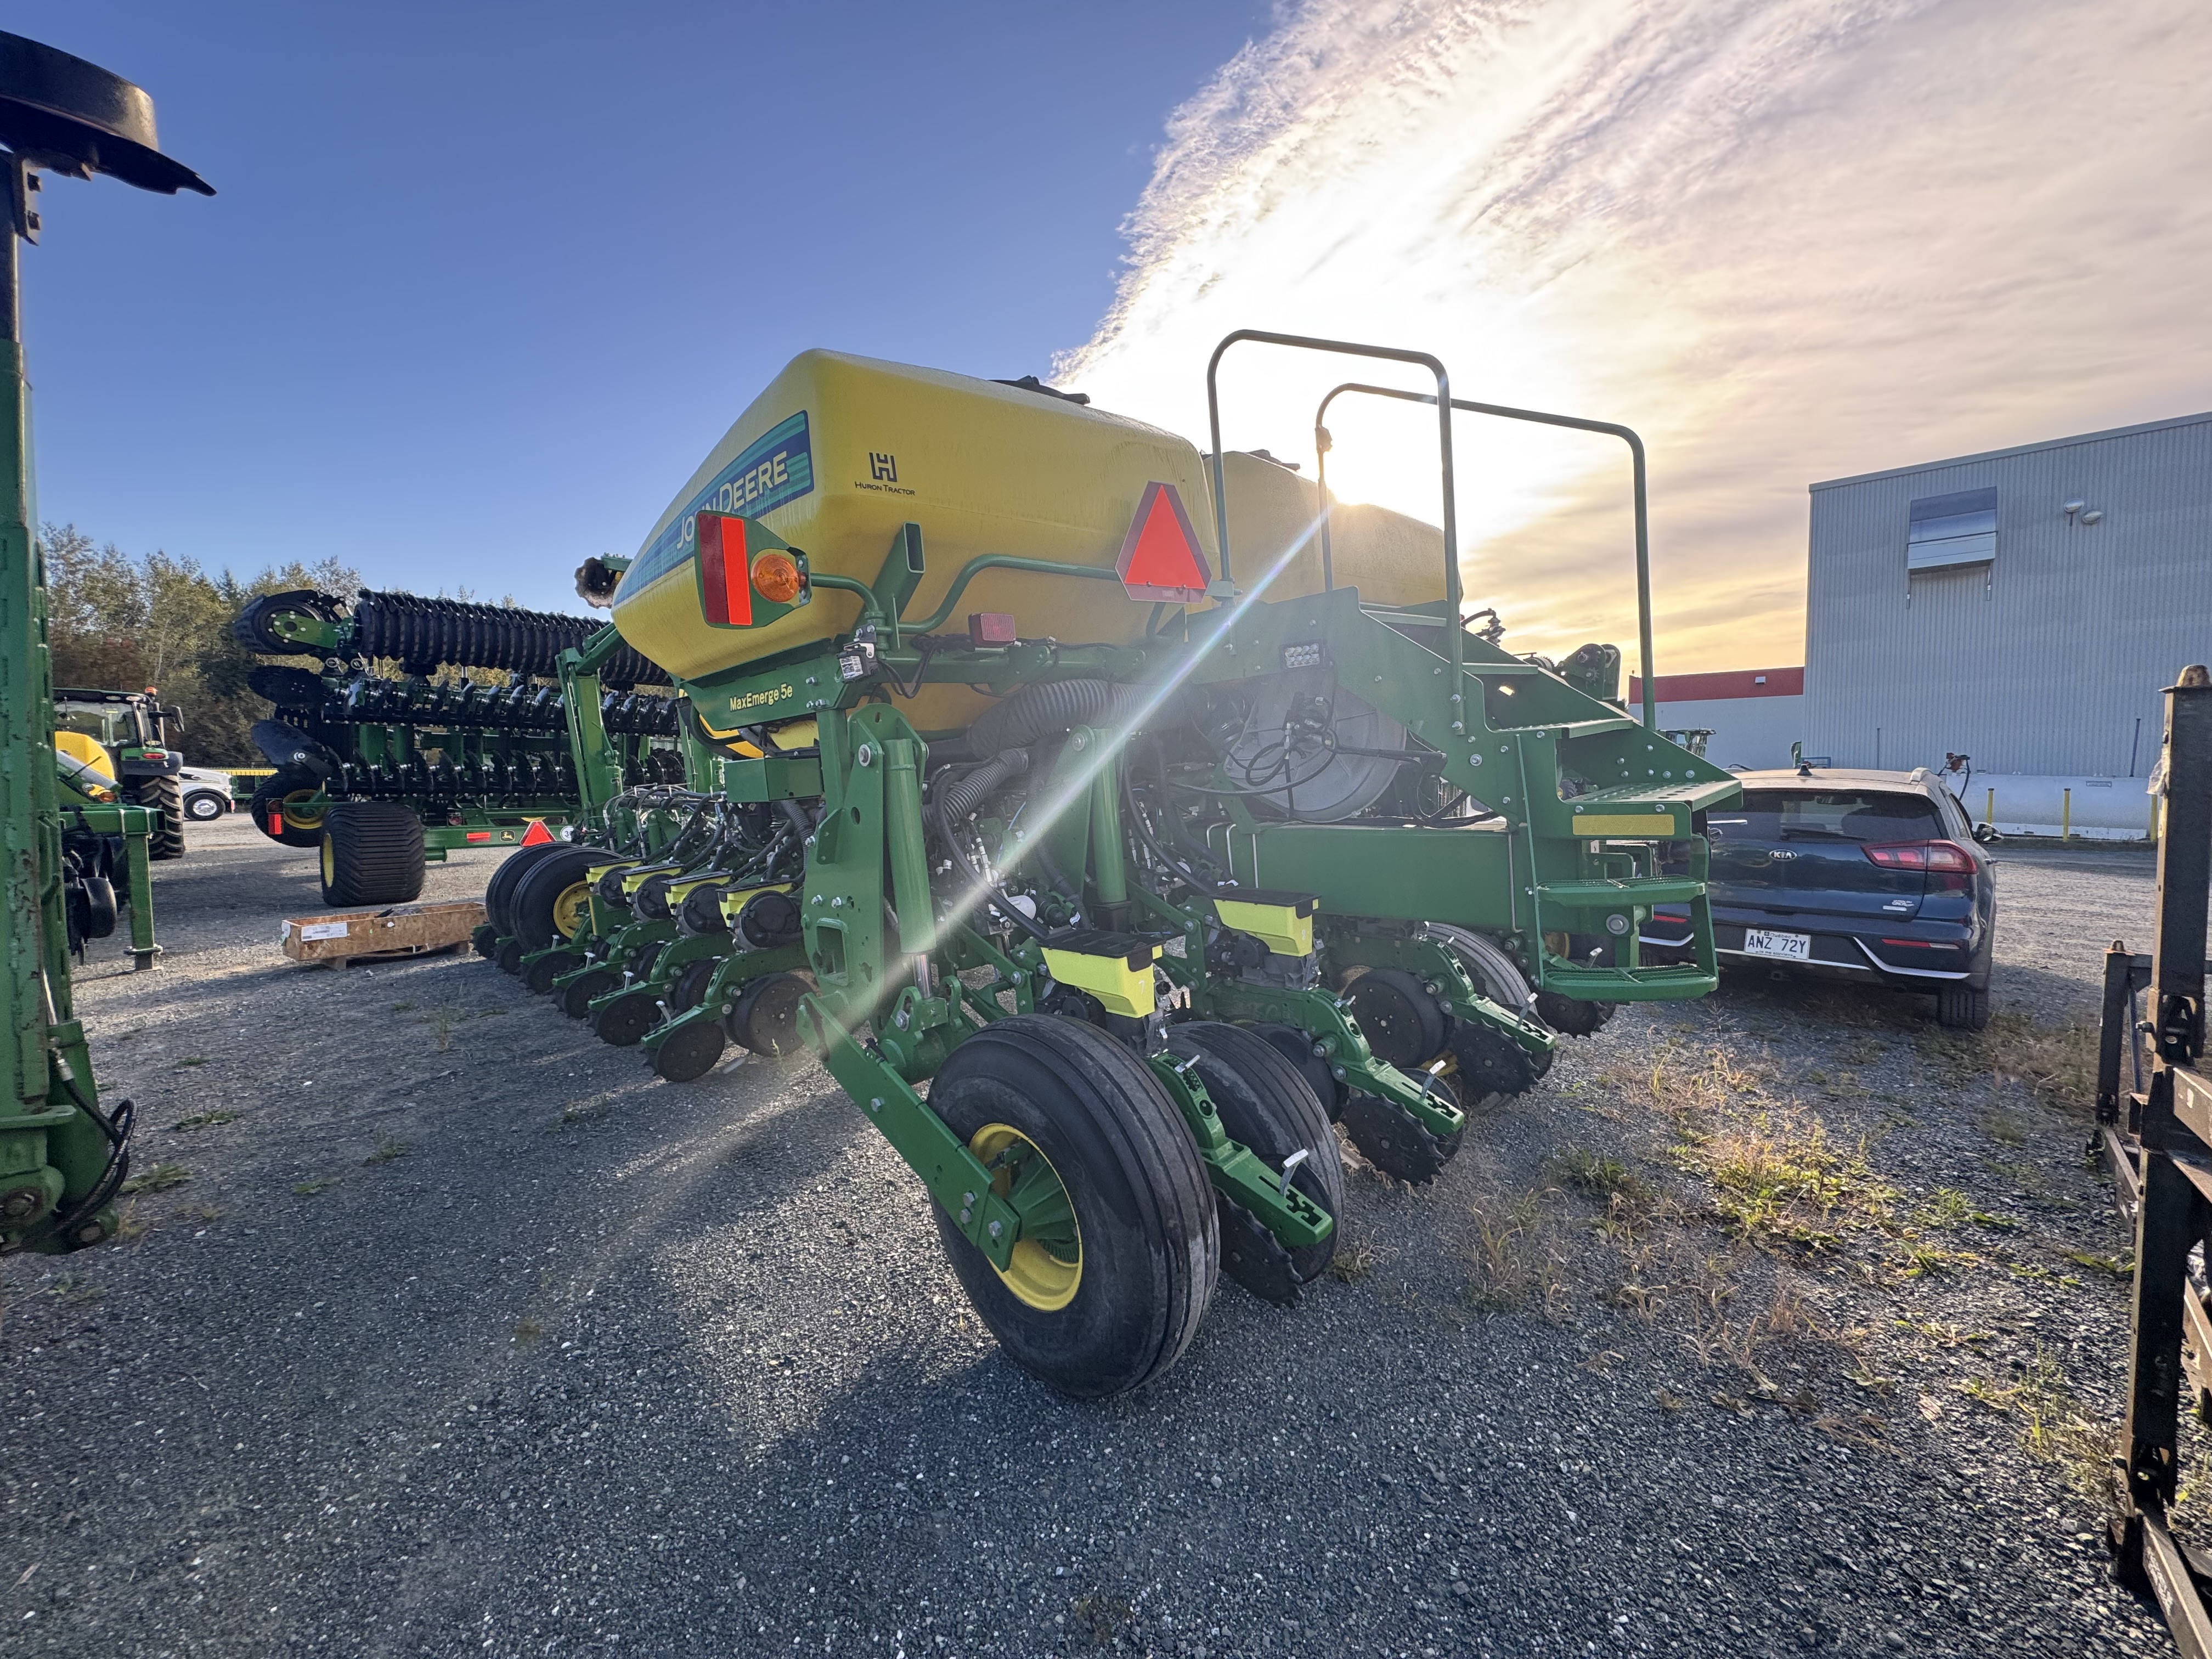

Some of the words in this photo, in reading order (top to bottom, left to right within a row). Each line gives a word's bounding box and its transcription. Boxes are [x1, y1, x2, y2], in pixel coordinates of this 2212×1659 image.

[677, 498, 716, 549] JO
[719, 451, 788, 514] DEERE
[730, 688, 779, 711] MaxEmerge
[781, 683, 793, 699] 5e
[1748, 935, 1773, 950] ANZ
[1781, 939, 1807, 953] 72Y
